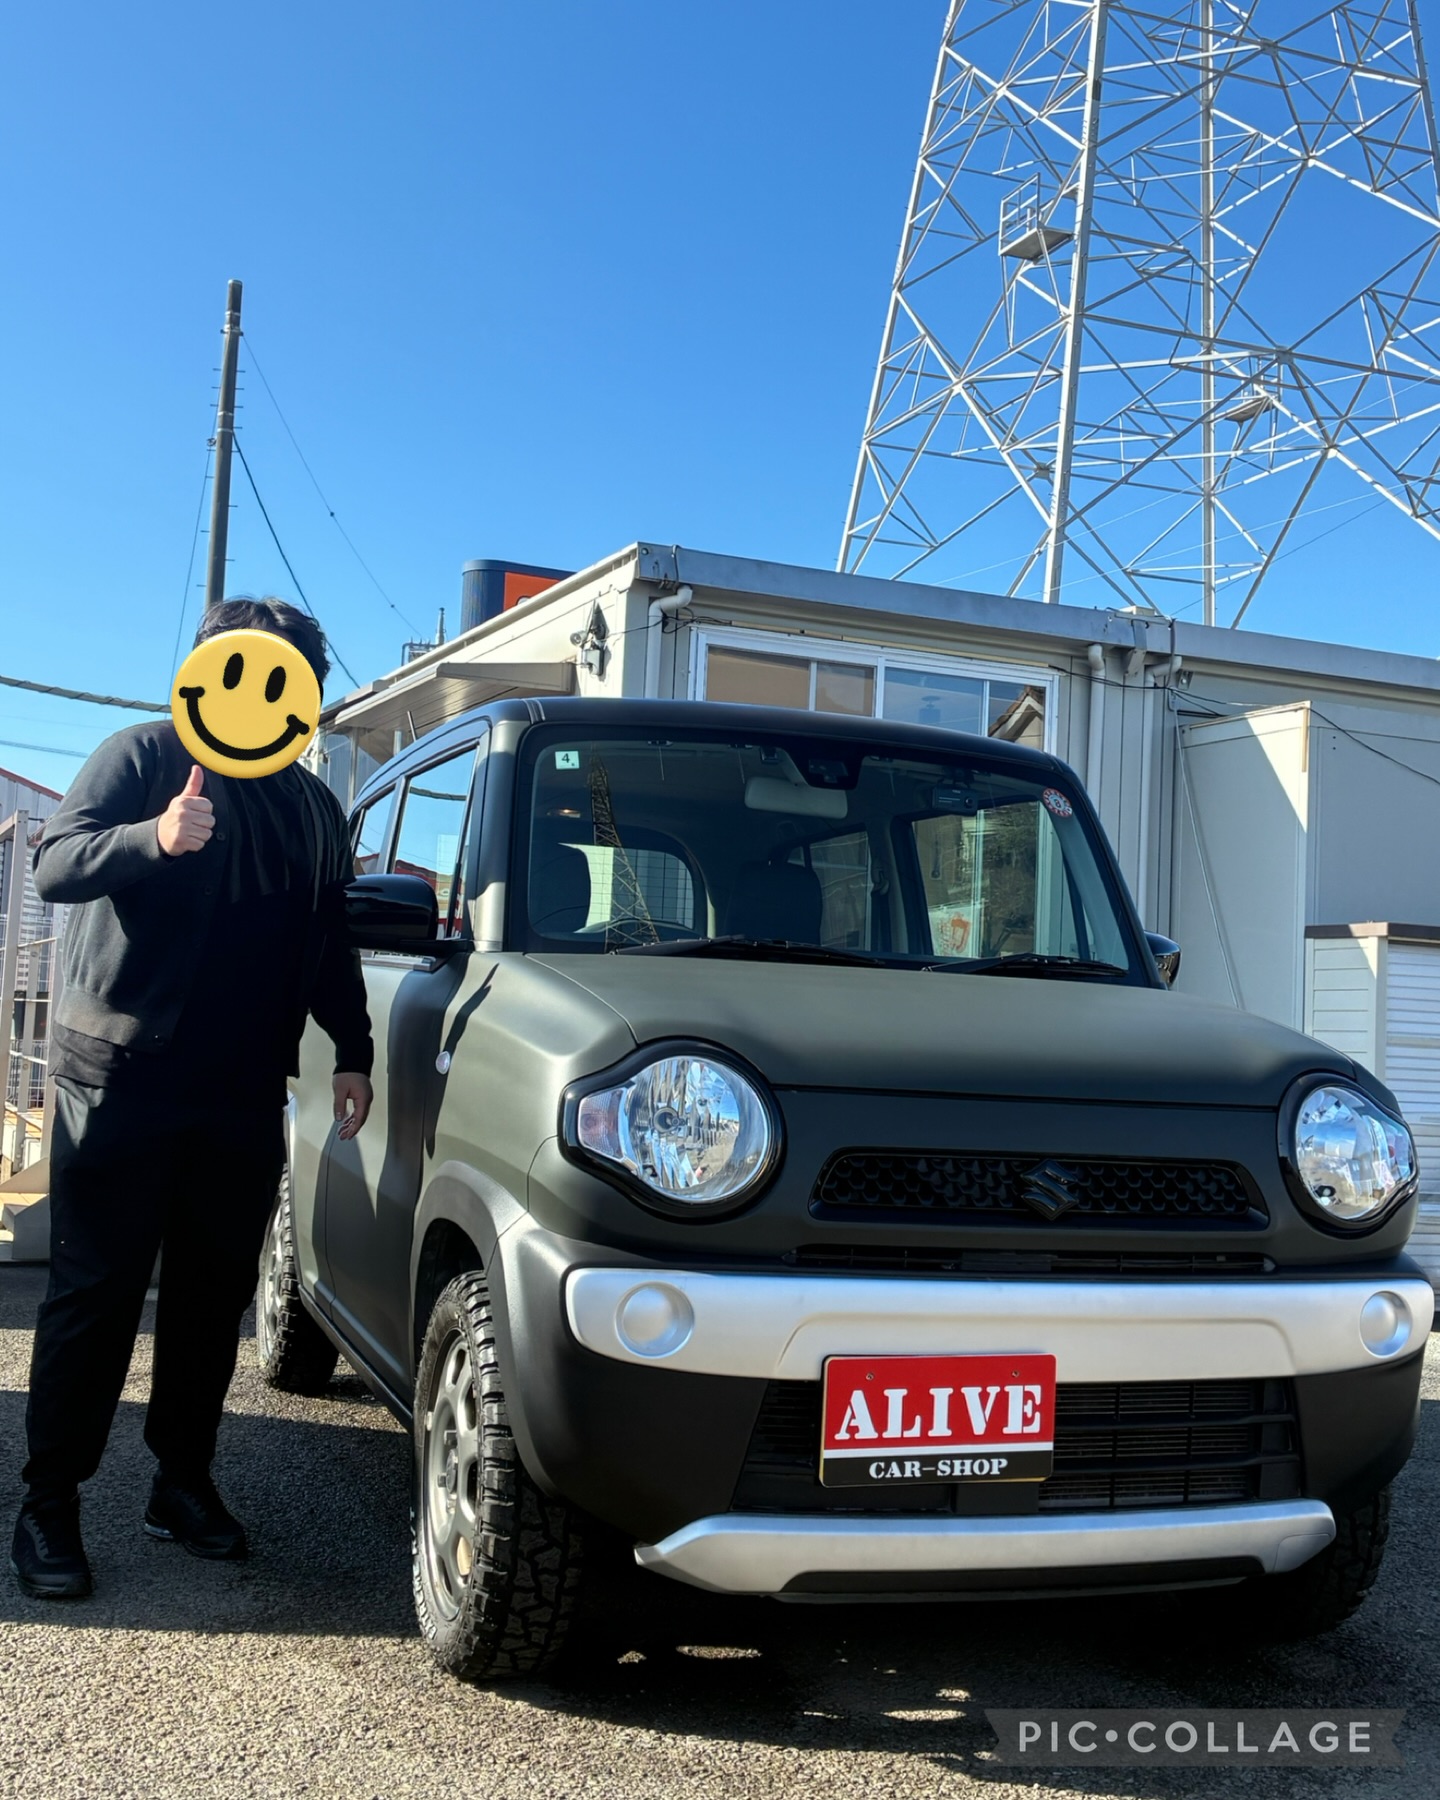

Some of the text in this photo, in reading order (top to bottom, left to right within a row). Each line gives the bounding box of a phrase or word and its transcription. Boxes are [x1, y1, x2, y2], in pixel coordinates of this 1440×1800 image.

[561, 753, 570, 763] 4
[834, 1385, 1041, 1440] ALIVE
[869, 1458, 1008, 1479] CAR-SHOP
[412, 1562, 437, 1640] EXTREME
